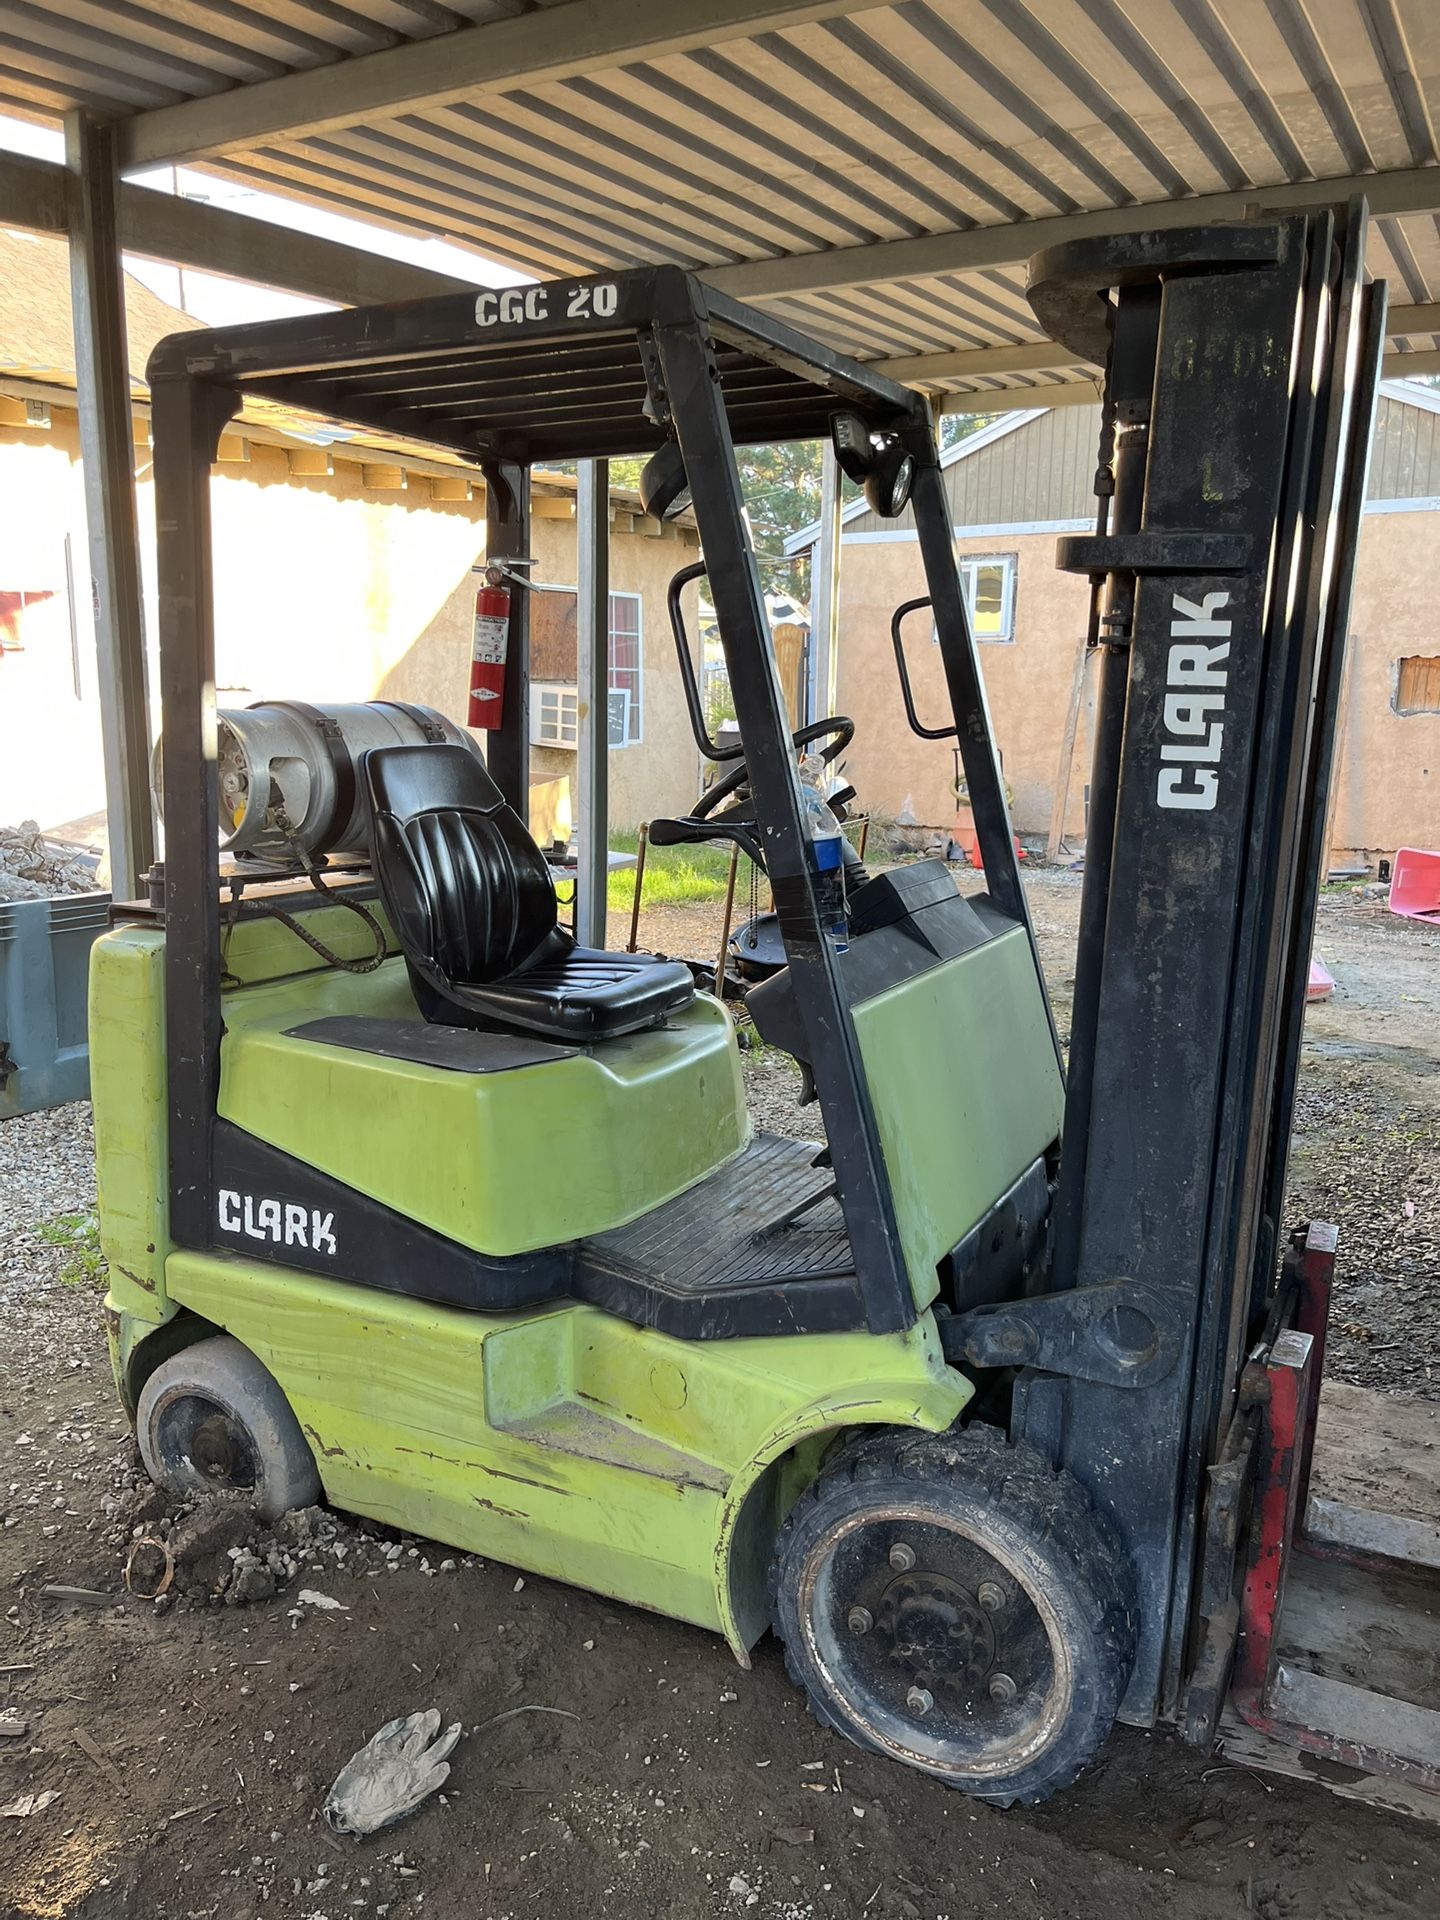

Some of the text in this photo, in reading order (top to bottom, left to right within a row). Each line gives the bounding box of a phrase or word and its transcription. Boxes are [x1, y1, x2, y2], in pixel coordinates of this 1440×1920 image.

[475, 284, 617, 326] CGC 20
[1156, 591, 1232, 811] CLARK
[218, 1189, 337, 1255] CLARK
